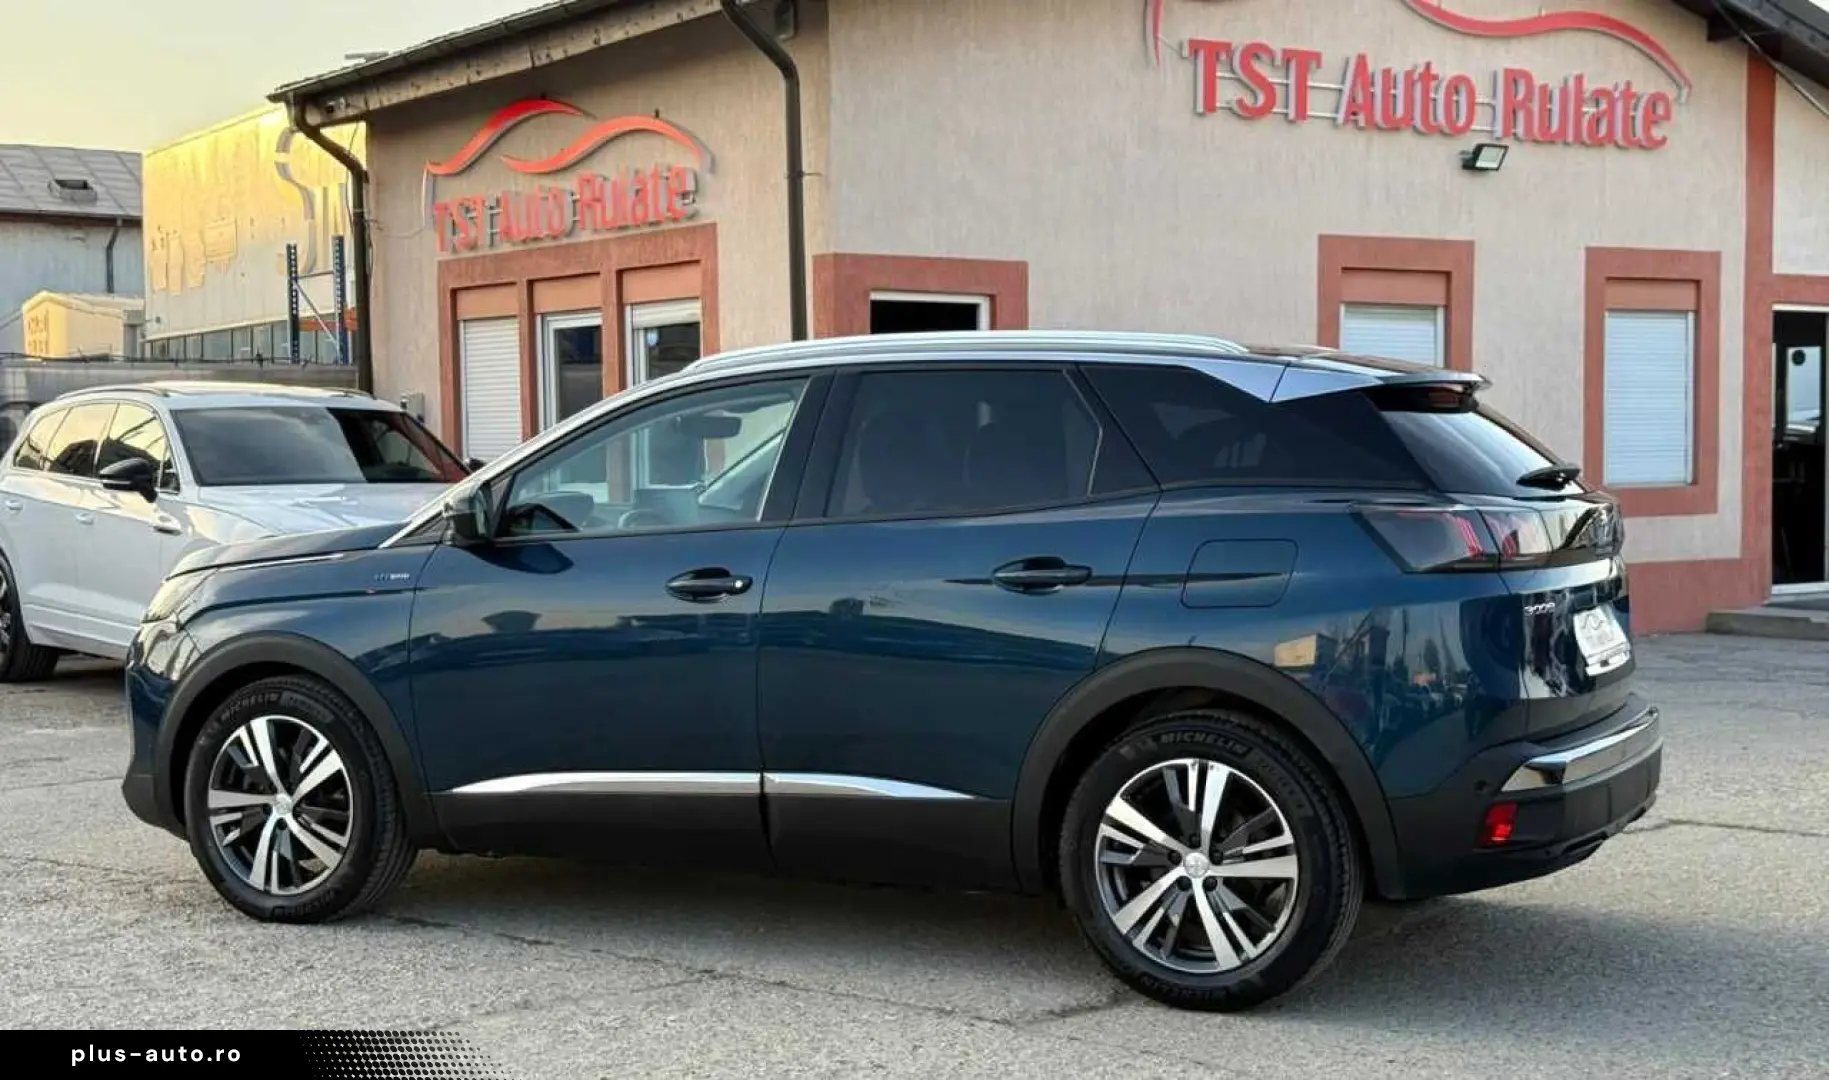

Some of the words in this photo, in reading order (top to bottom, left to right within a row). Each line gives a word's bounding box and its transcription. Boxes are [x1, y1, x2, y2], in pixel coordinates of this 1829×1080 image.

[1187, 38, 1322, 121] TST
[1338, 52, 1477, 136] Auto
[1495, 67, 1673, 150] Rulate
[434, 195, 486, 252] TST
[500, 184, 567, 242] Auto
[576, 164, 690, 231] Rulate
[1159, 730, 1249, 755] MICHELIN
